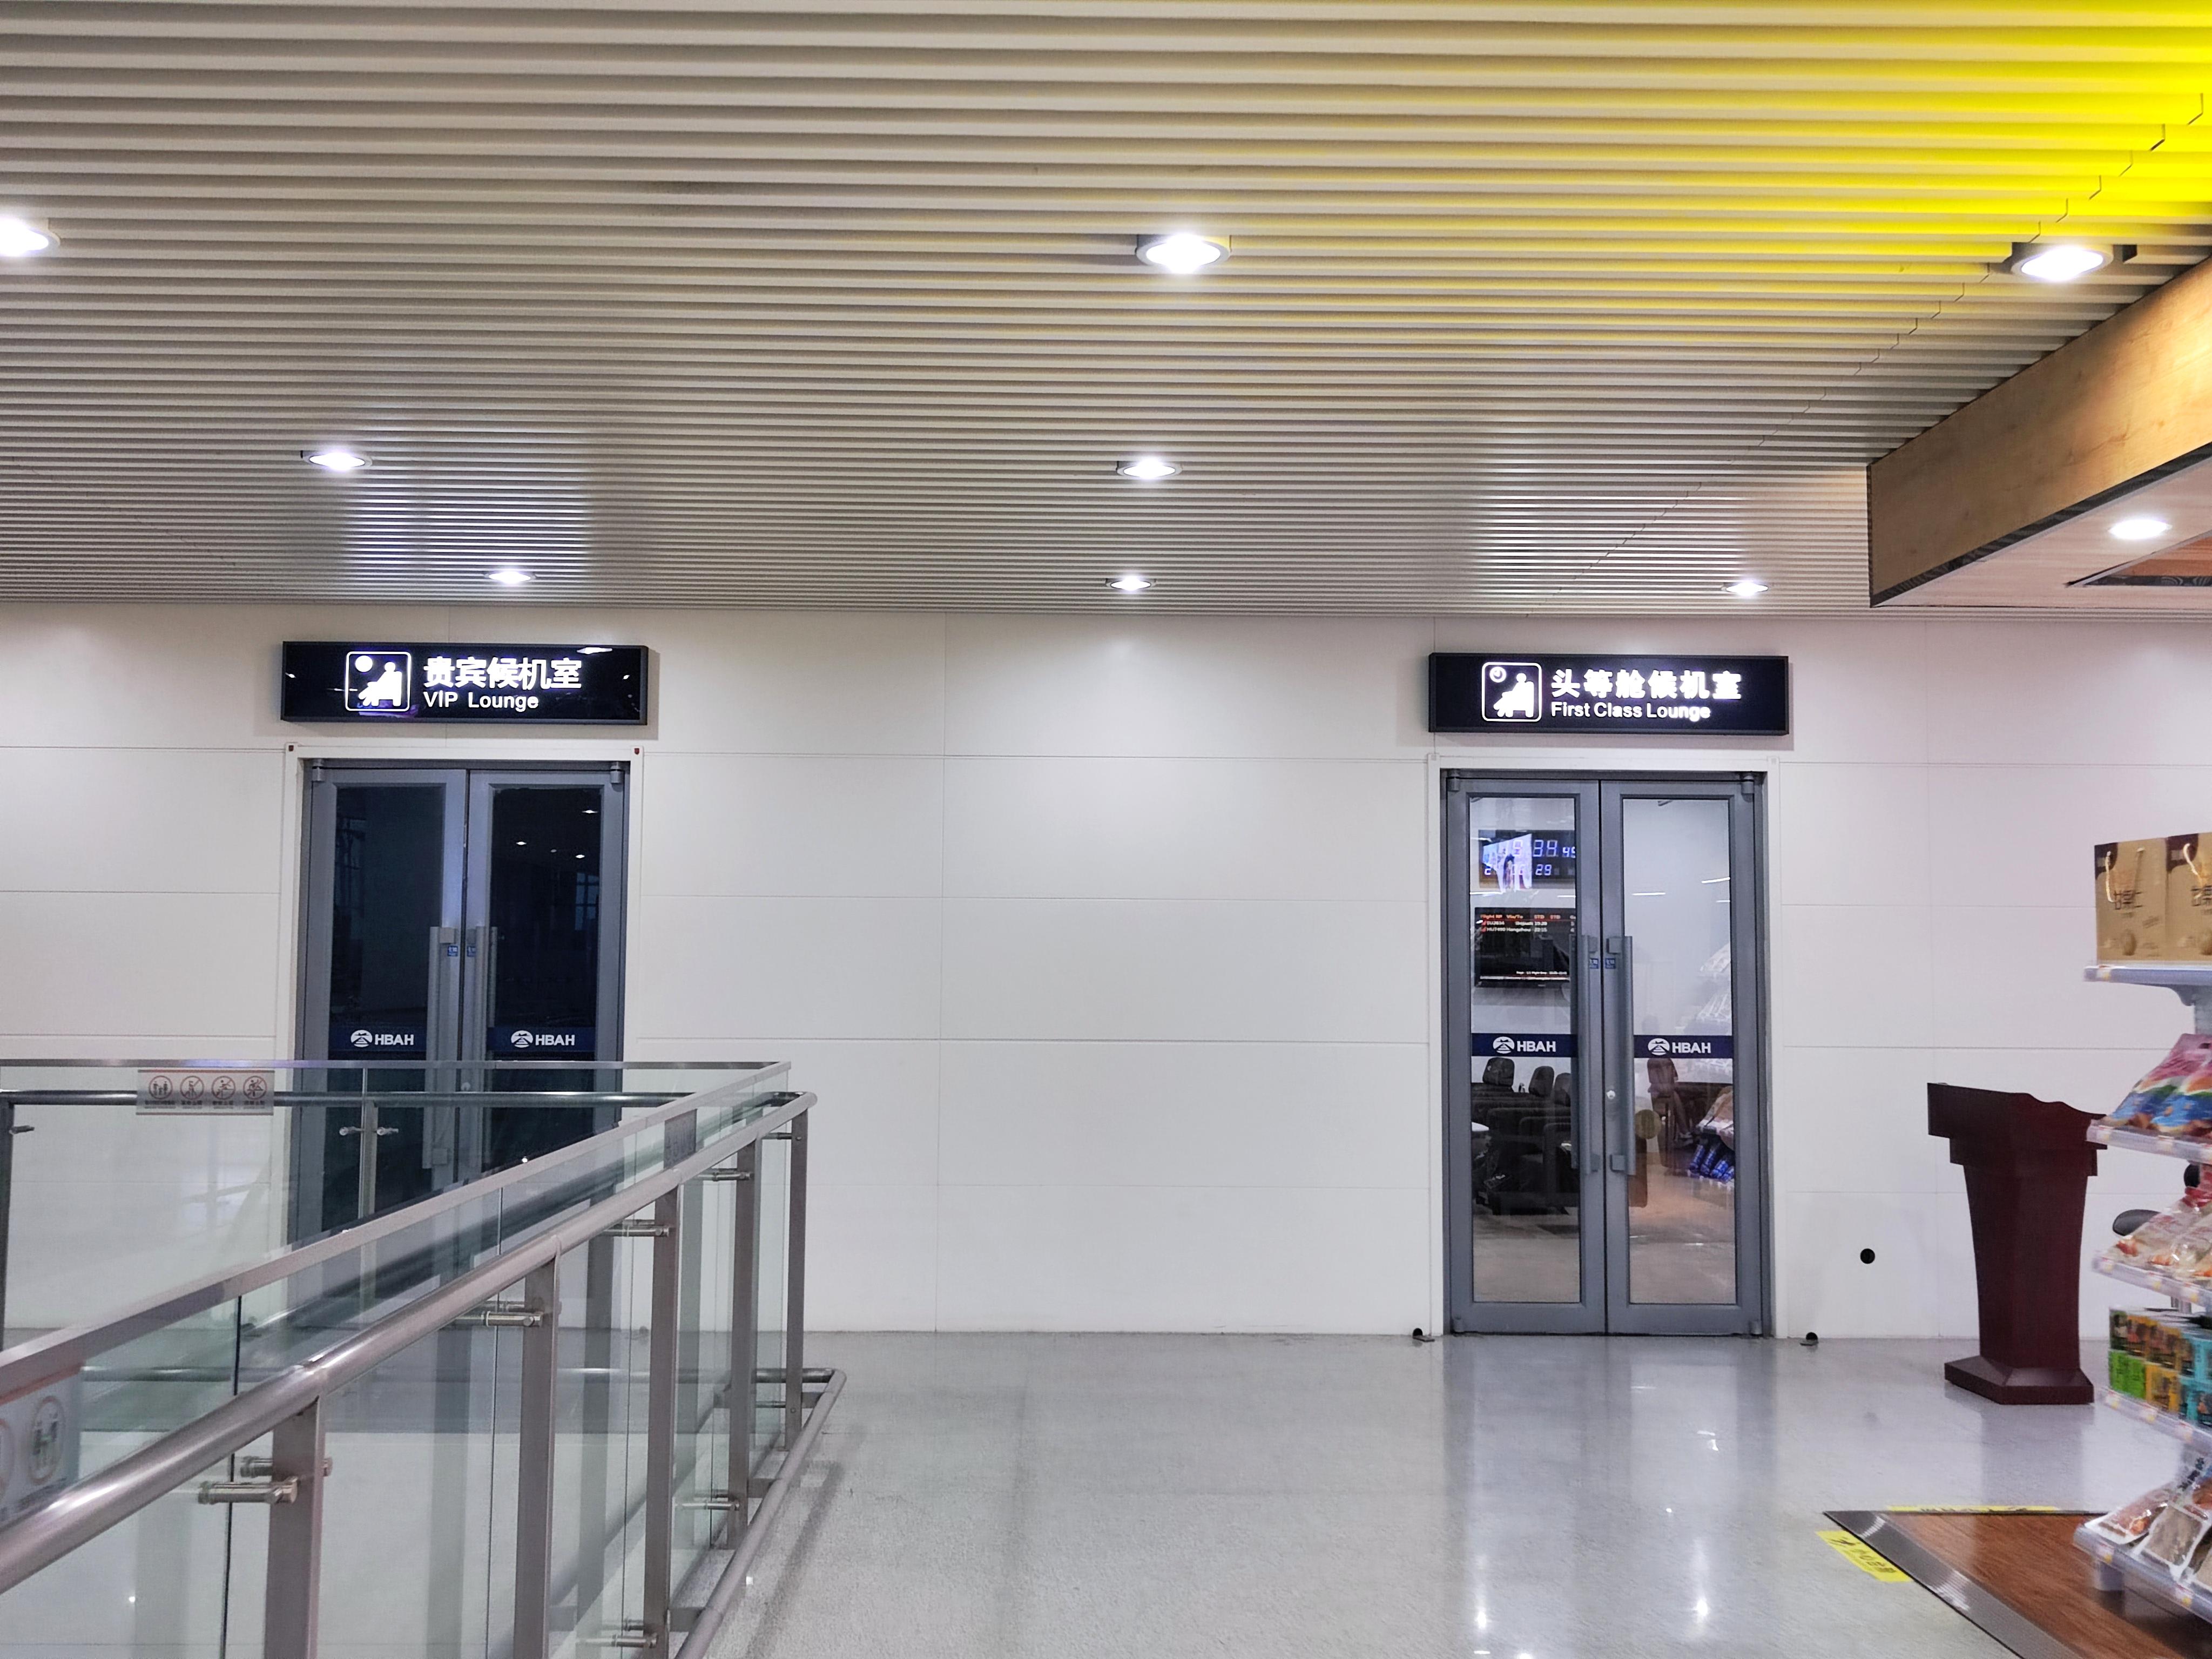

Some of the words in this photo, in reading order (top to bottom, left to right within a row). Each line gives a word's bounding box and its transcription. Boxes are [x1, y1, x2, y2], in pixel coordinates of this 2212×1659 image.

[423, 657, 582, 691] 贵宾候机室
[1551, 669, 1742, 700] 头等舱候机室
[423, 691, 458, 708] VIP
[468, 692, 539, 712] Lounge
[1550, 702, 1591, 718] First
[1593, 702, 1643, 718] Class
[1646, 703, 1711, 722] Lounge
[374, 1034, 414, 1046] HBAH
[535, 1034, 575, 1046] HBAH
[1516, 1041, 1556, 1052] HBAH
[1672, 1042, 1711, 1054] HBAH
